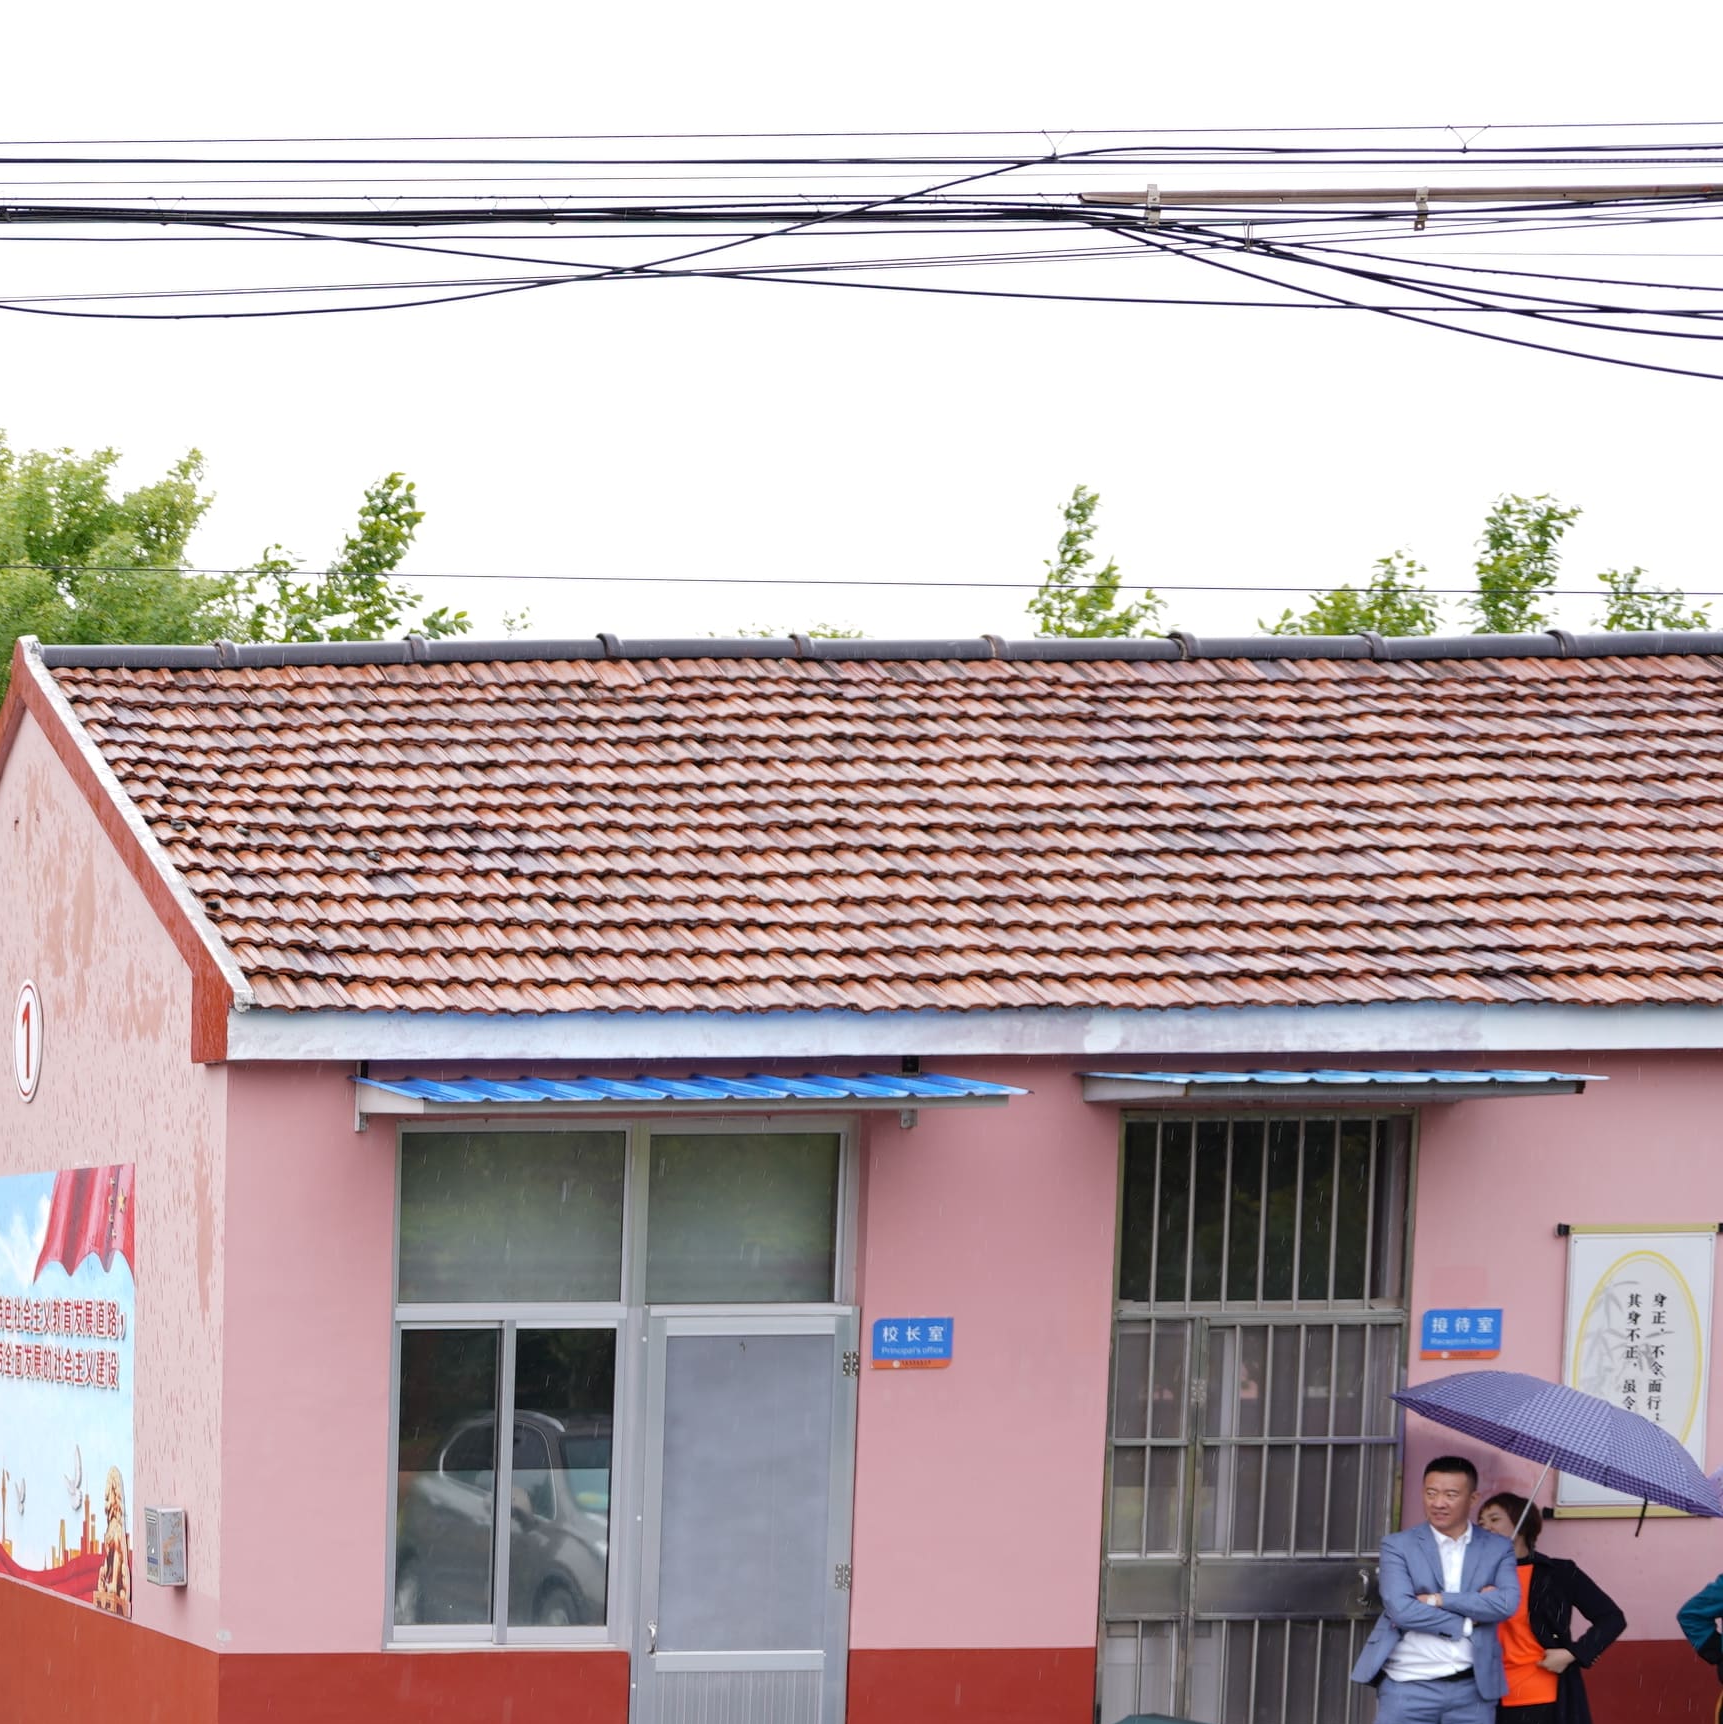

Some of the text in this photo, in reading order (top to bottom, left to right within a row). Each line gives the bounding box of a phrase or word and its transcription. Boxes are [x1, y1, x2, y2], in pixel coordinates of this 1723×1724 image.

[21, 1002, 31, 1079] 1
[882, 1325, 945, 1343] 校长室
